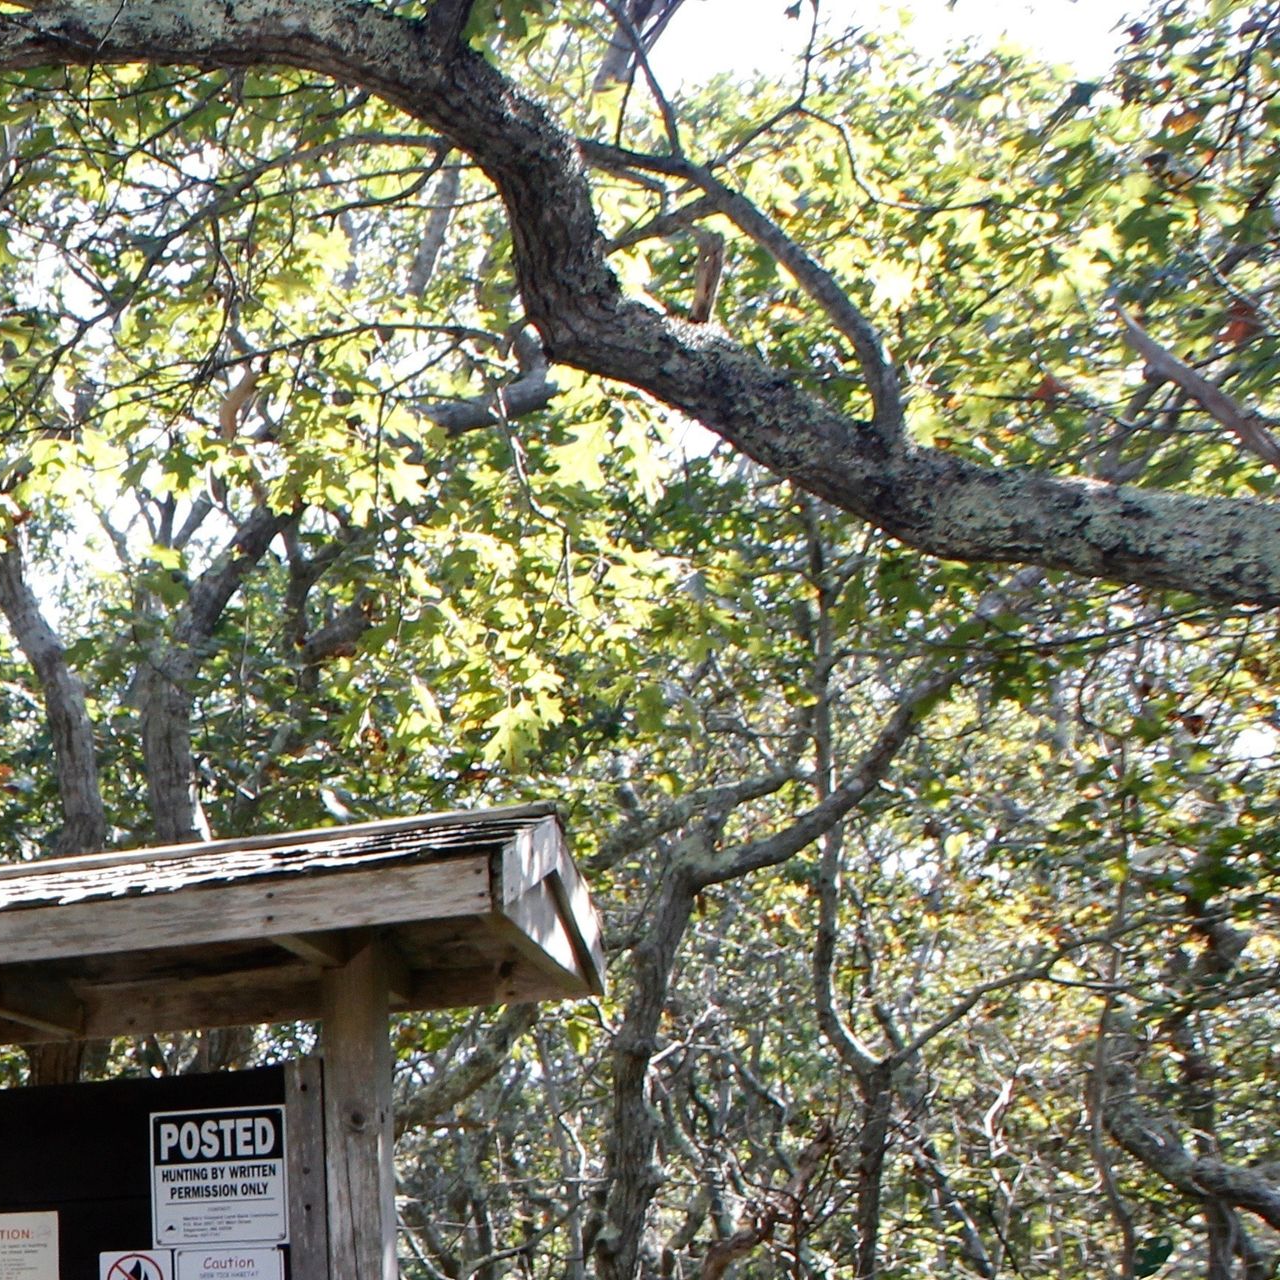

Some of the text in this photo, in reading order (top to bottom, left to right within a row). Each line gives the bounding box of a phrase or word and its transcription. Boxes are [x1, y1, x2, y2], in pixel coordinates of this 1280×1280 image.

[160, 1117, 275, 1160] POSTED
[162, 1164, 276, 1182] HUNTING BY WRITTEN
[170, 1182, 269, 1199] PERMISSION ONLY
[203, 1256, 255, 1269] Caution
